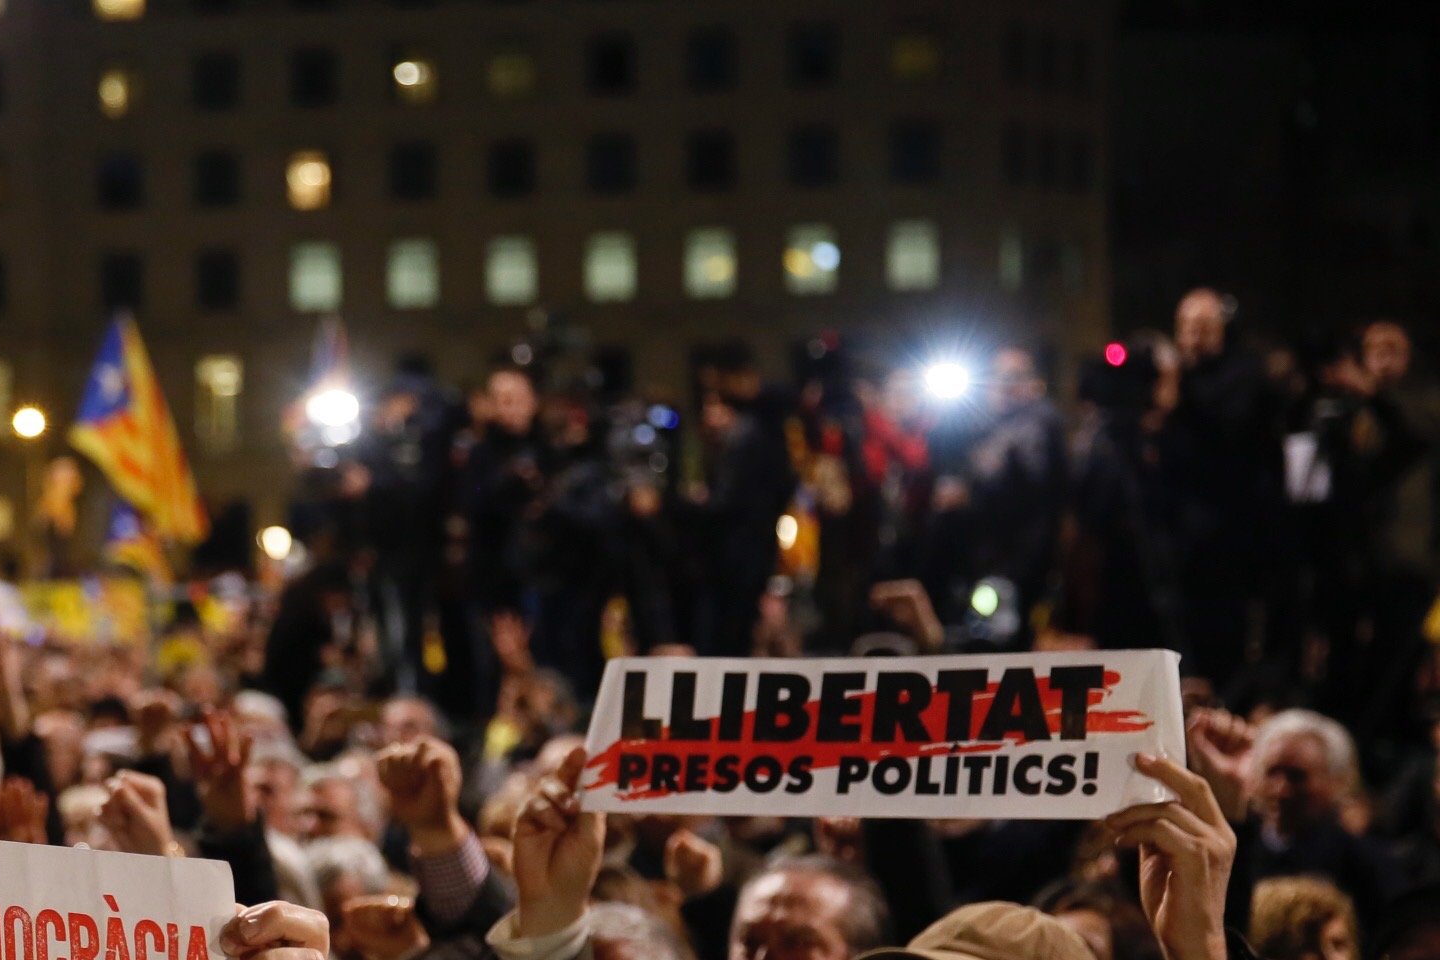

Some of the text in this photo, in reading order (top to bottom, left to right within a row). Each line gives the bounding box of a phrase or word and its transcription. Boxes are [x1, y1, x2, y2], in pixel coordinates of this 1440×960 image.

[620, 665, 1105, 744] LLIBERTAT
[616, 742, 1100, 796] PRESOS POLÍTICS!
